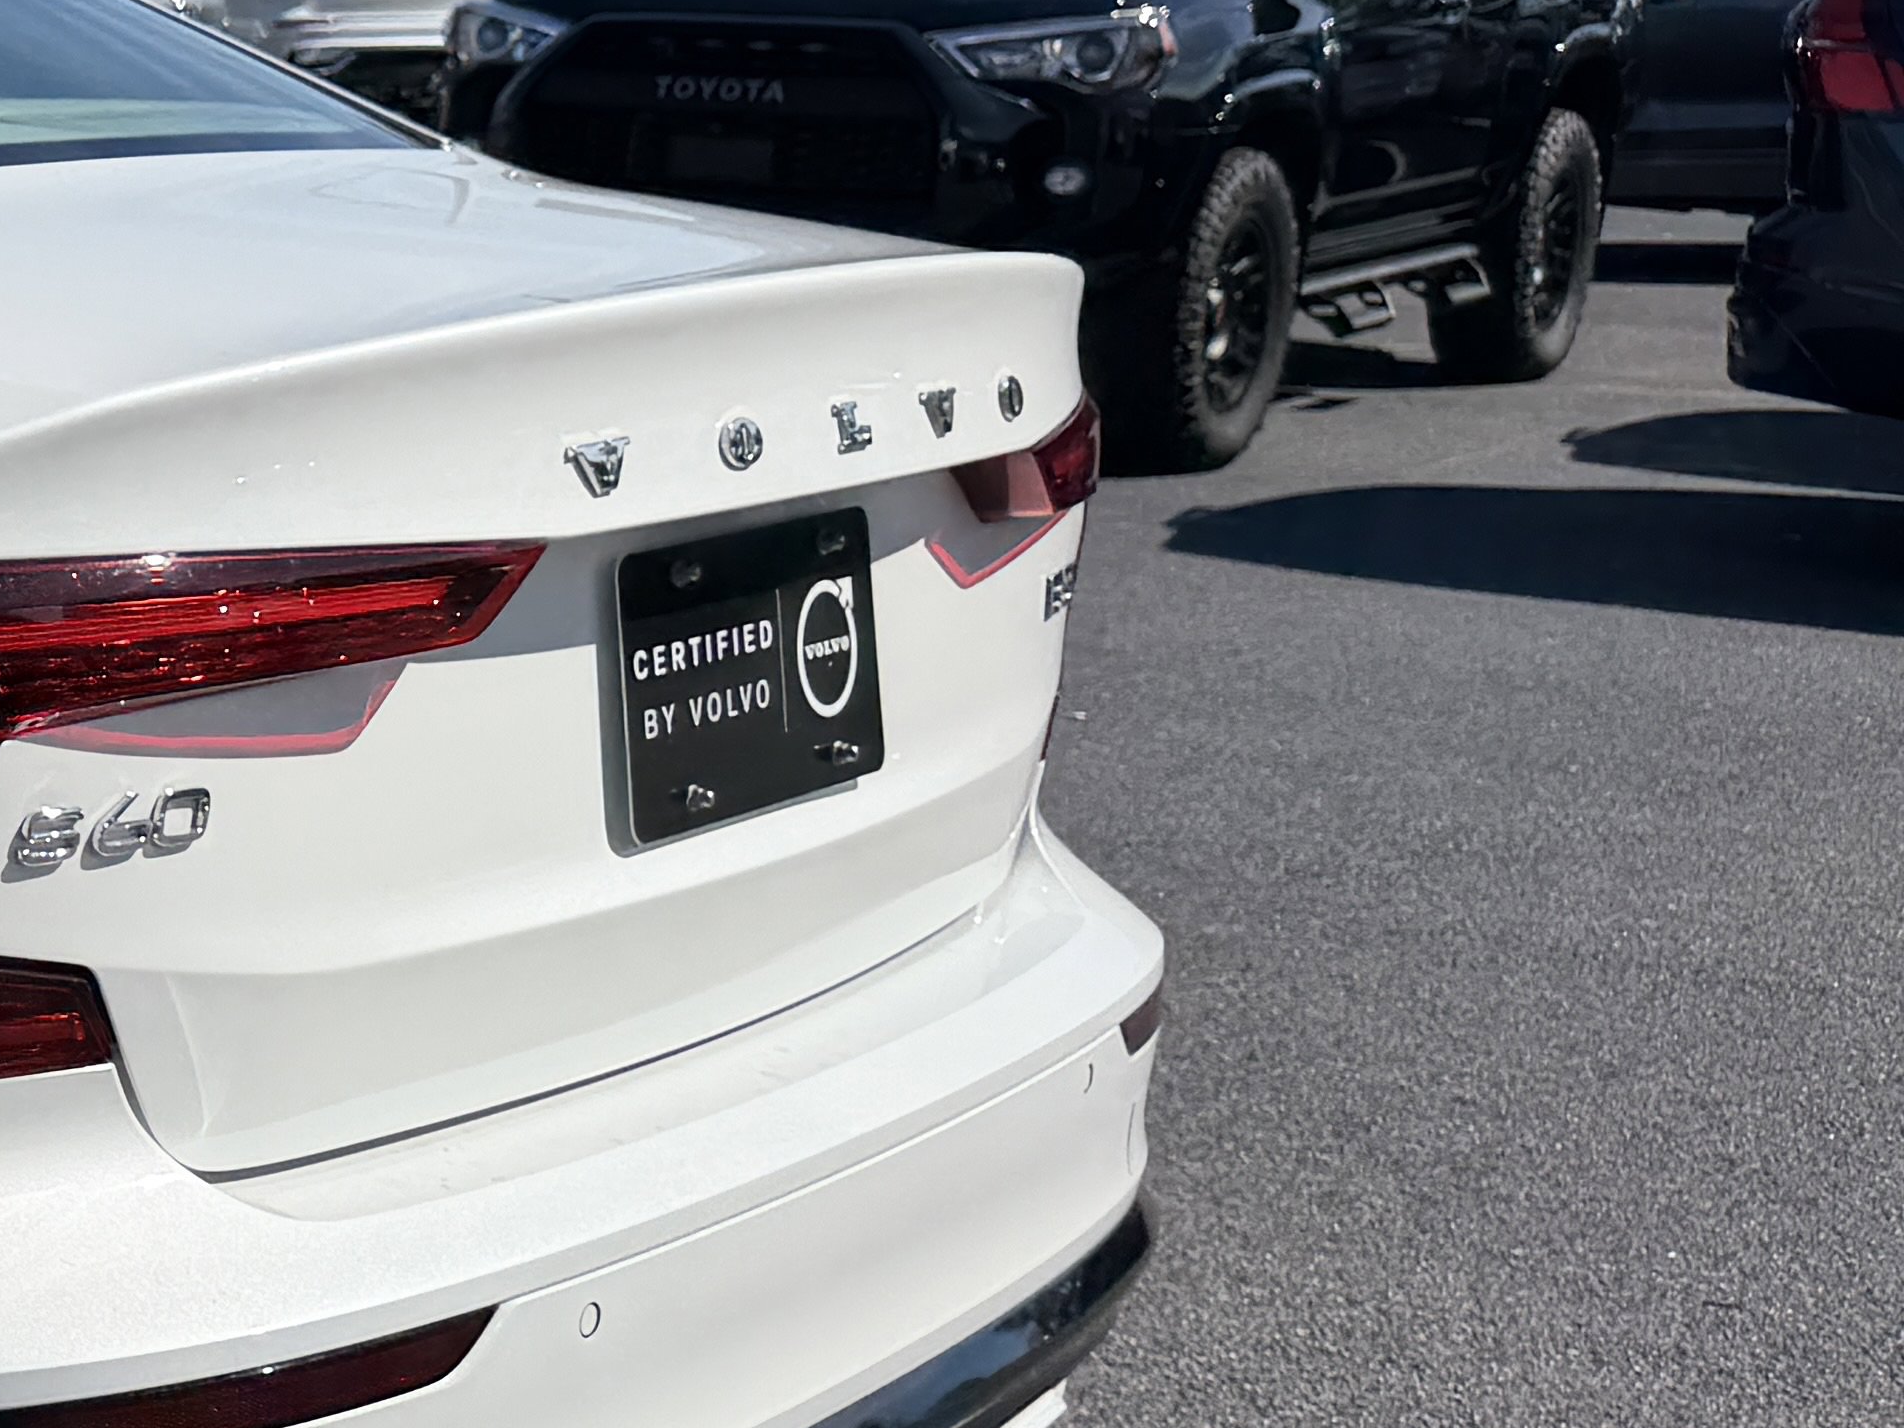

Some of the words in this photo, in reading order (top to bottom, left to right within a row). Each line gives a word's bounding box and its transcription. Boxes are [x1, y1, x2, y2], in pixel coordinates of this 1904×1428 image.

[654, 73, 784, 104] TOYOTA
[563, 375, 1025, 499] VOLVO
[632, 619, 773, 680] CERTIFIED
[804, 635, 850, 660] VOLVO
[644, 703, 675, 740] BY
[688, 679, 770, 727] VOLVO
[14, 785, 212, 868] S60
